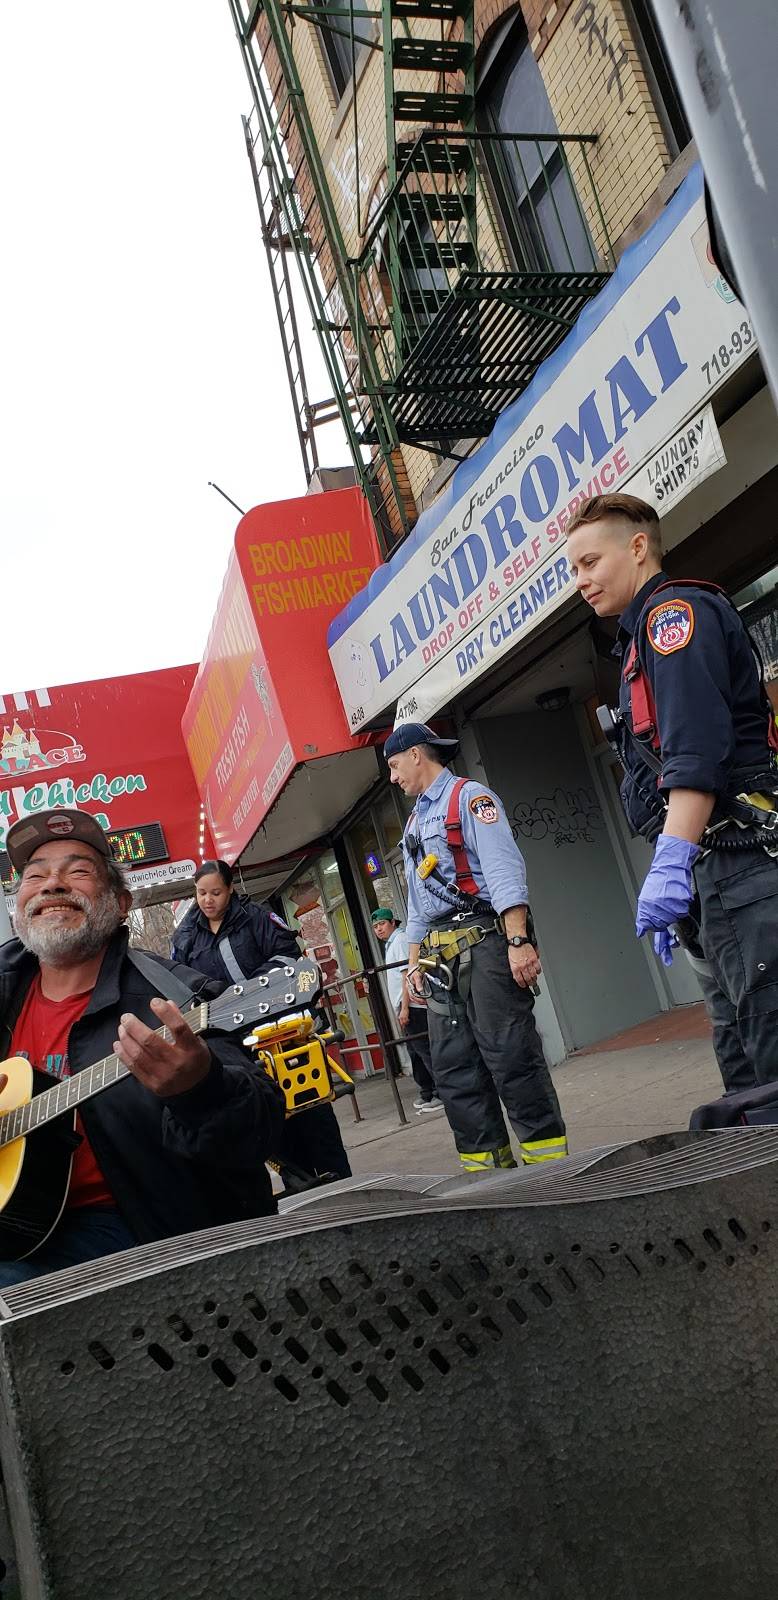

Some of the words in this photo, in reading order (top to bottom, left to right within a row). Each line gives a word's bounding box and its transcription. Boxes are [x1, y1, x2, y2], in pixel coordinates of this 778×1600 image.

[647, 419, 704, 486] LAUNDRY
[654, 450, 700, 501] SHIRTS
[370, 295, 688, 683] LAUNDROMAT
[430, 525, 459, 568] San
[462, 424, 544, 532] Francisco
[248, 531, 352, 576] BROADWAY
[421, 621, 454, 664] DROP
[459, 592, 484, 631] OFF
[488, 580, 501, 602] &
[503, 536, 542, 588] SELF
[455, 637, 486, 678] DRY
[489, 556, 576, 648] CLEANER
[22, 773, 147, 811] Chicken
[168, 864, 193, 875] Cream
